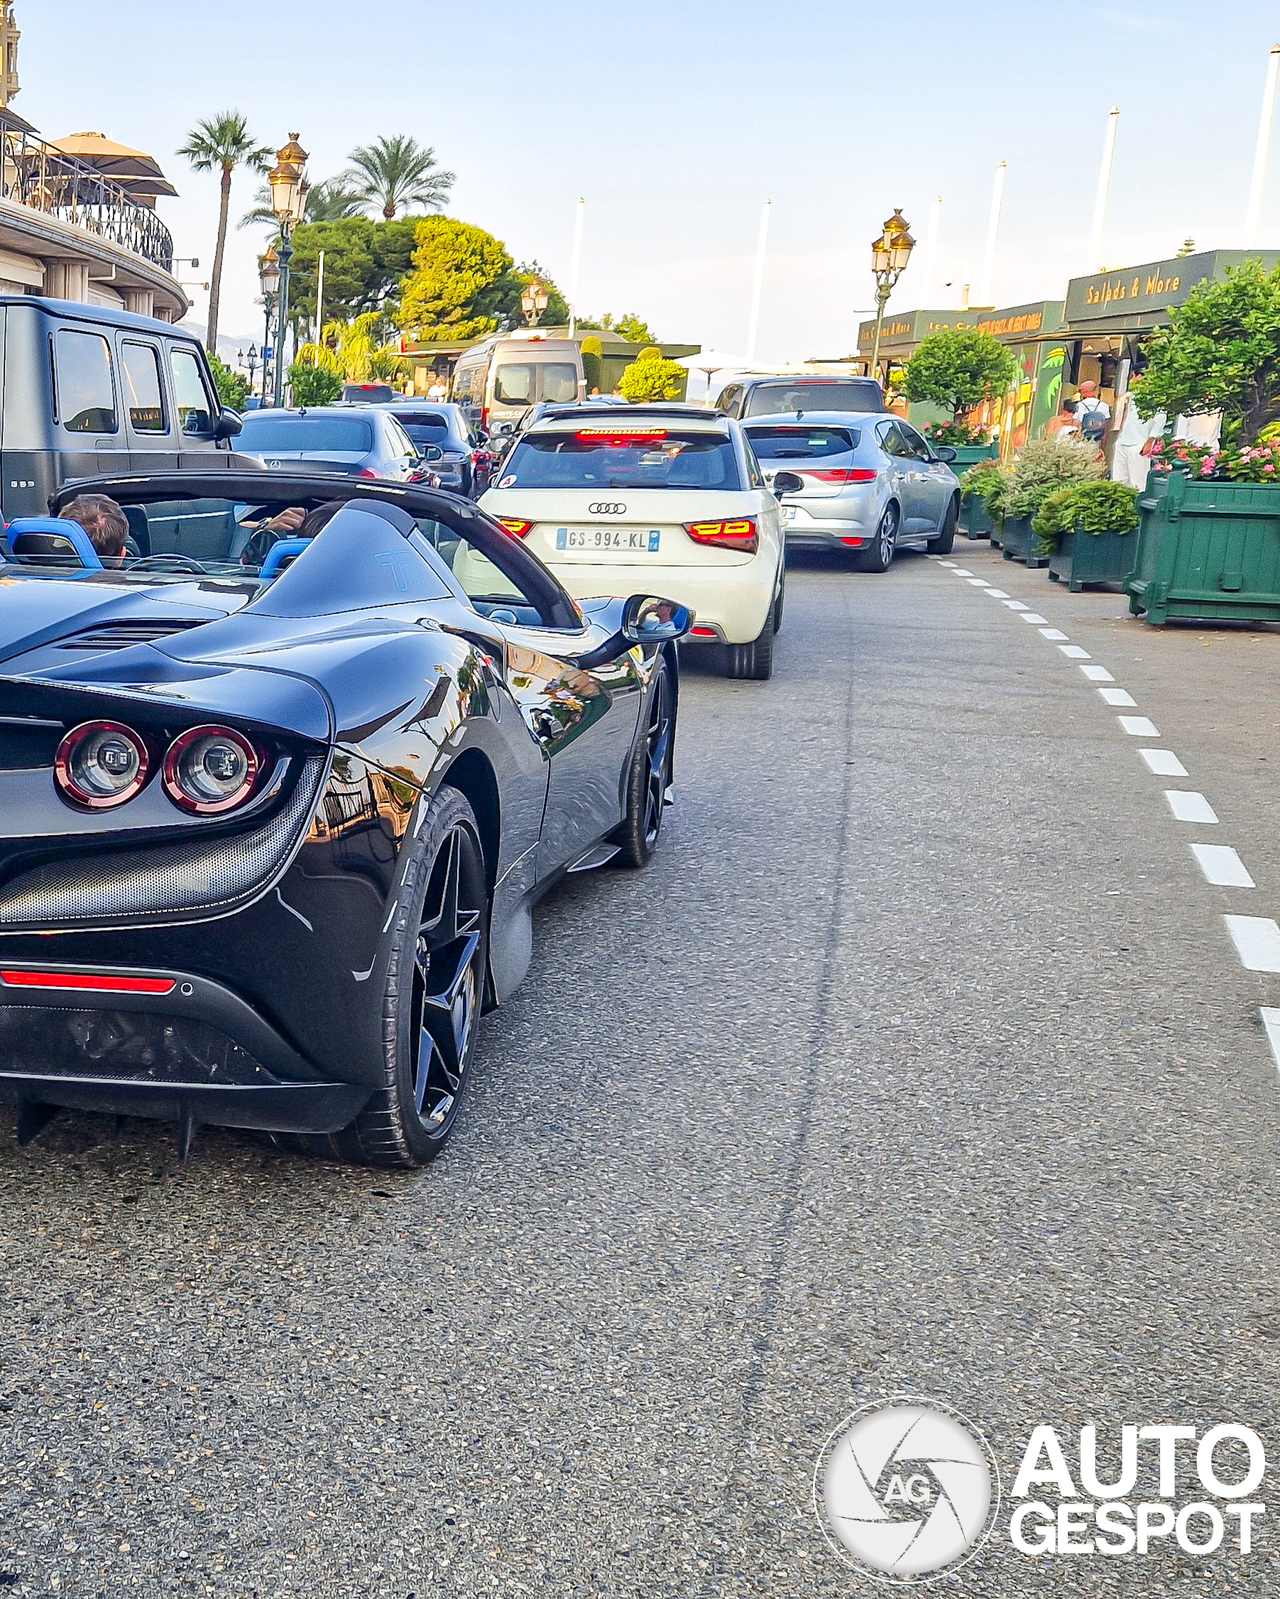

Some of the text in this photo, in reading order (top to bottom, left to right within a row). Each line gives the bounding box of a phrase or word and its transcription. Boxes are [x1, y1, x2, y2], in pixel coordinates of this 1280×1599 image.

[1086, 274, 1180, 305] Salads & More
[569, 531, 646, 548] GS-994-KL
